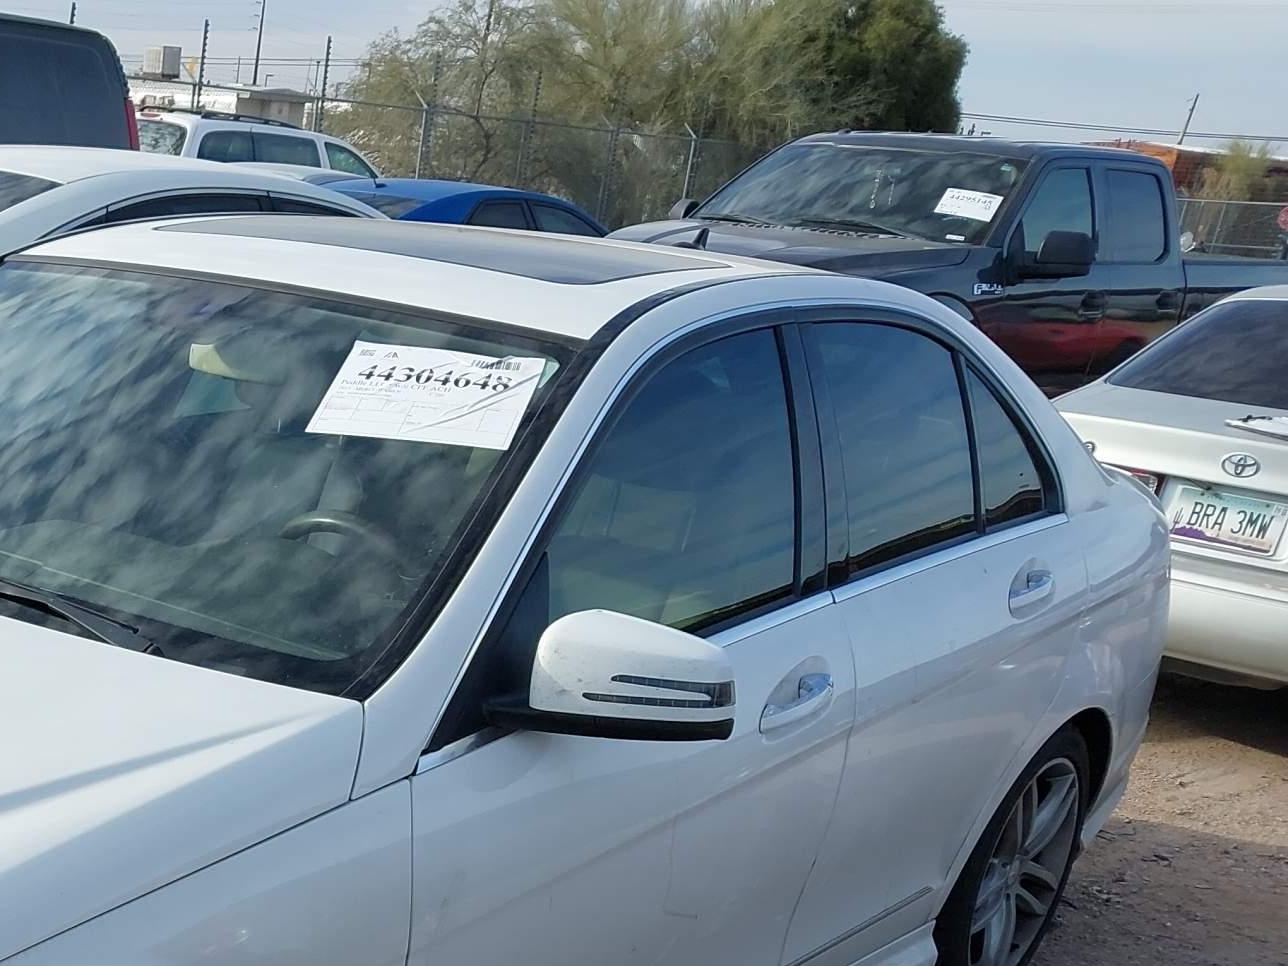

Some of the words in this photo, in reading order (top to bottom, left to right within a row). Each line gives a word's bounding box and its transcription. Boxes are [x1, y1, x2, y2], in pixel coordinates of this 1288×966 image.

[358, 364, 512, 392] 44304648
[1187, 501, 1228, 532] BRA
[1230, 510, 1275, 540] 3MW
